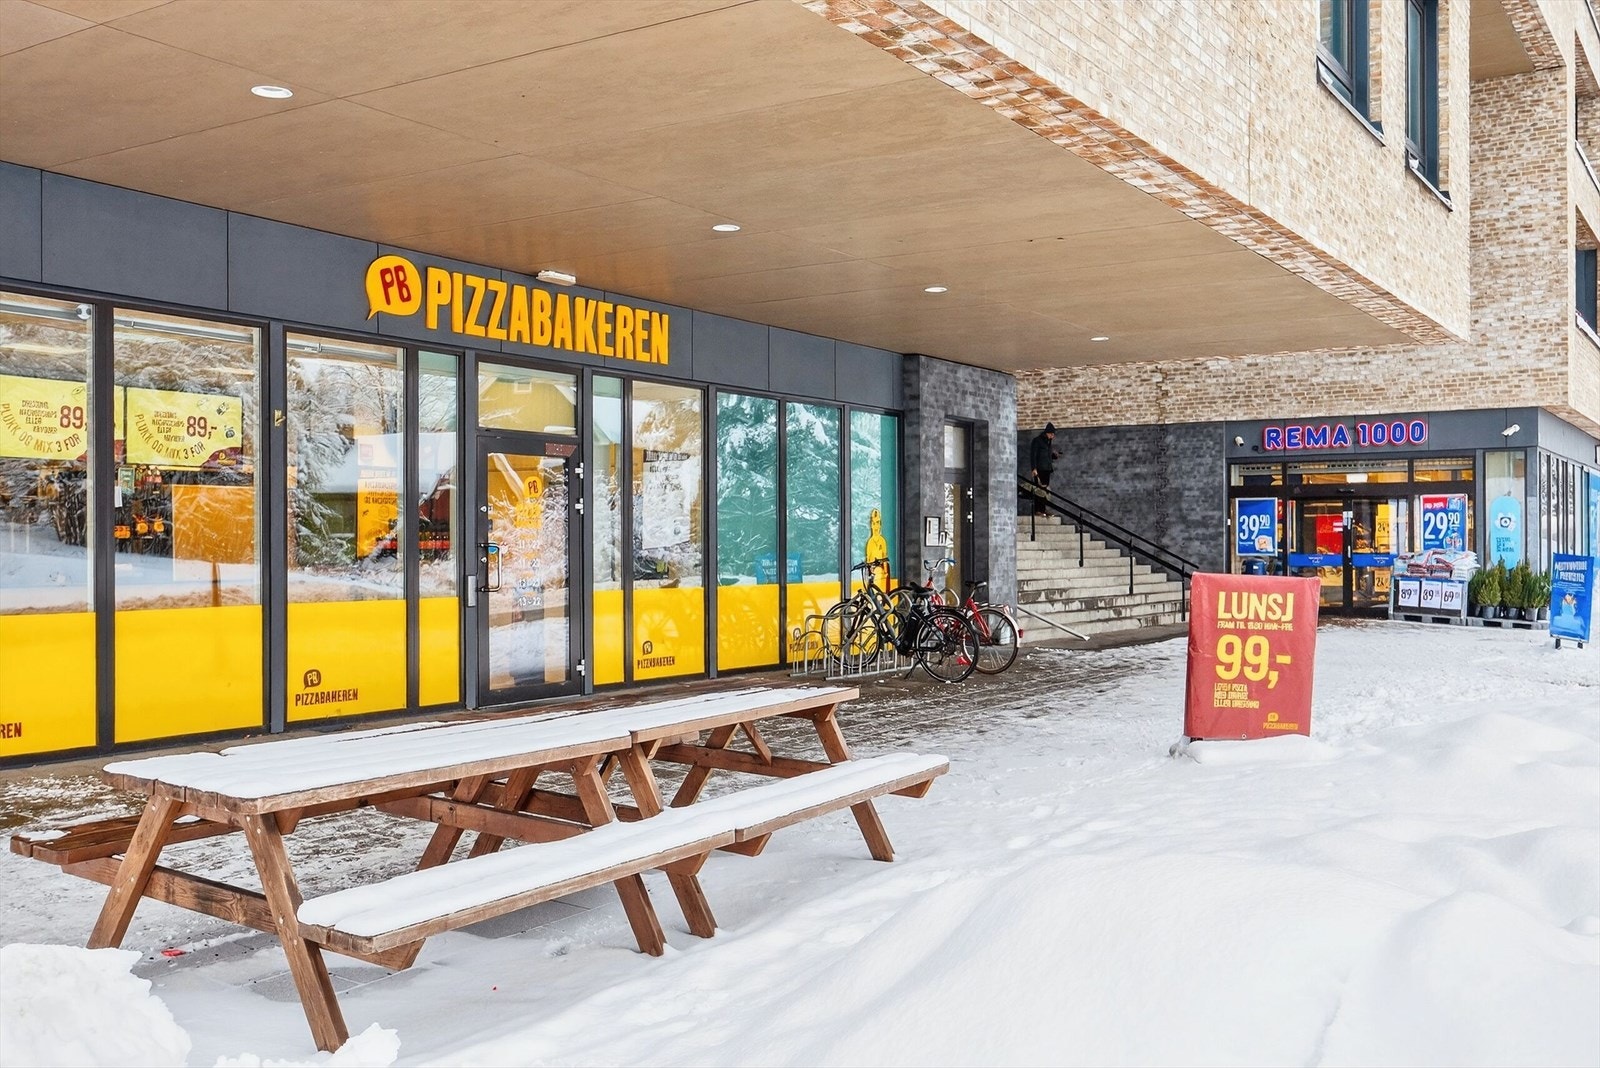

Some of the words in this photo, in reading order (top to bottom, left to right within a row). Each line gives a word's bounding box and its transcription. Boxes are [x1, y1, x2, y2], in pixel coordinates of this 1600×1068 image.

[379, 264, 412, 306] PB
[425, 266, 669, 365] PIZZABAKEREN
[0, 403, 21, 436] PLUKK
[33, 439, 54, 453] MIX
[55, 440, 63, 453] 3
[63, 433, 82, 451] FOR
[186, 415, 217, 440] 89,-
[1263, 425, 1351, 450] REMA
[1357, 419, 1428, 446] 1000
[182, 448, 189, 460] 3
[189, 441, 206, 458] FOR
[1424, 512, 1449, 540] 29
[1217, 591, 1294, 621] LUNSJ
[1216, 634, 1292, 689] 99,-
[295, 688, 359, 706] PIZZABAKEREN
